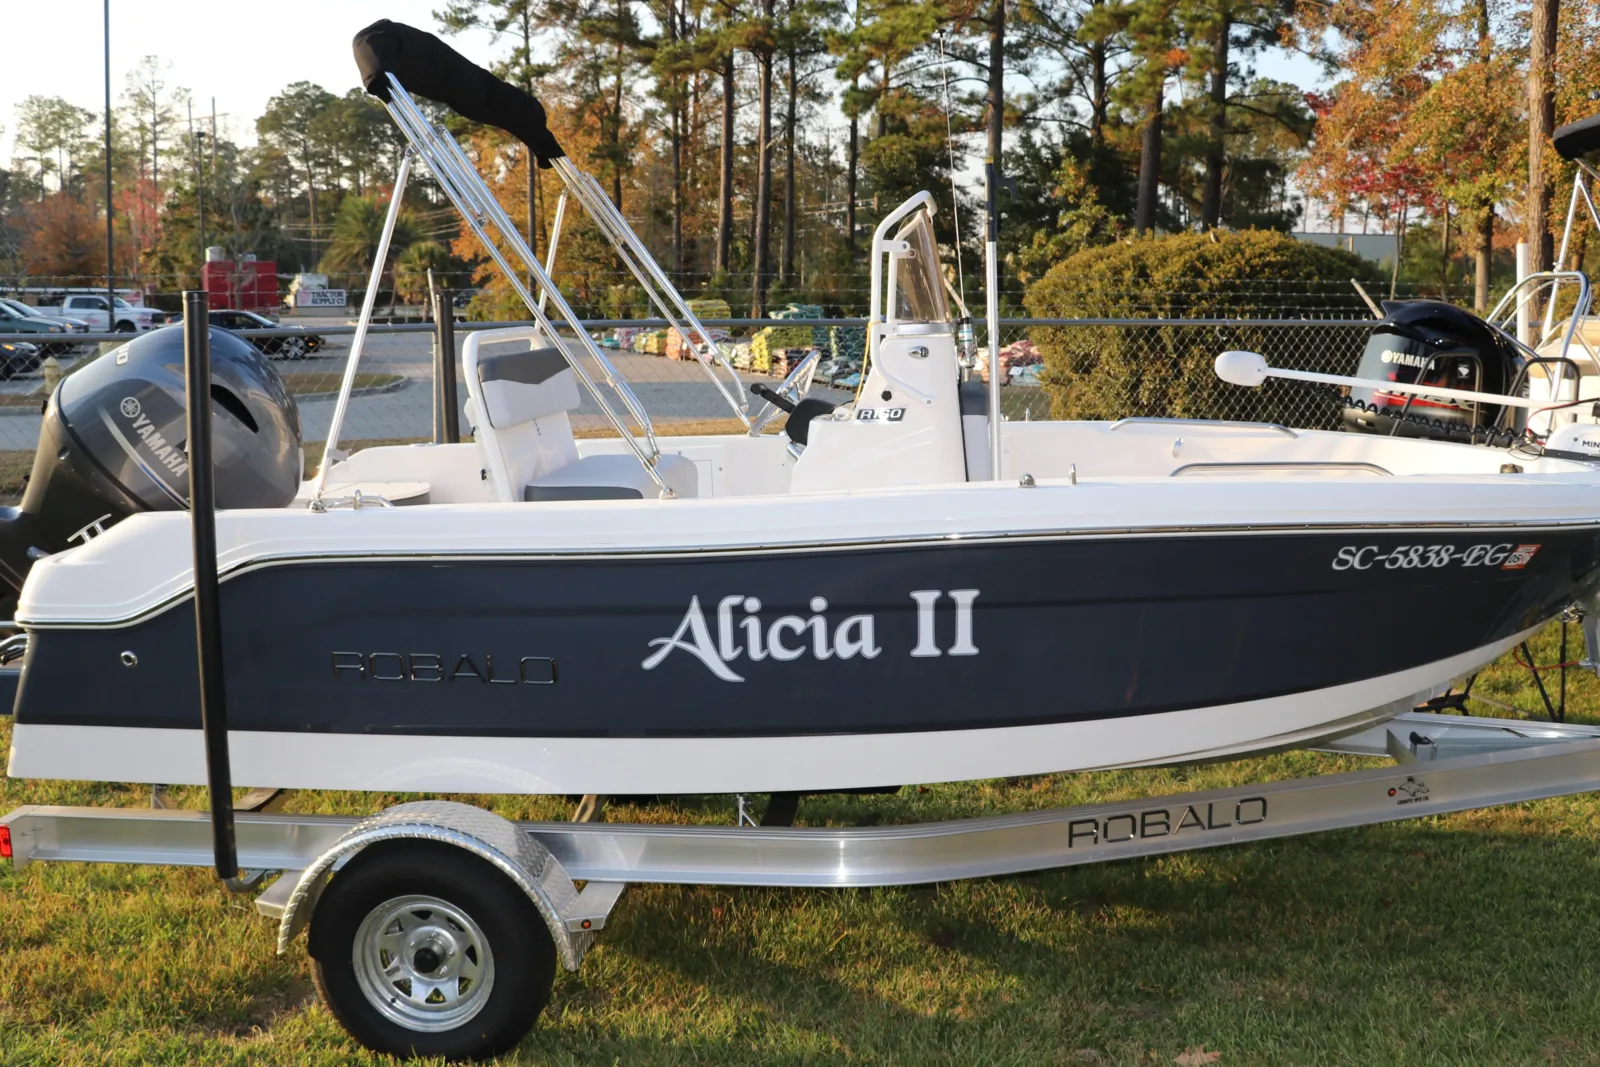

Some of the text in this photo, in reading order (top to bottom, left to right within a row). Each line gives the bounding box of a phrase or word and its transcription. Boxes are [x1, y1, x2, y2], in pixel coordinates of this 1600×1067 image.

[1393, 351, 1435, 370] YAMAHA
[132, 412, 189, 478] YAMAHA
[1331, 544, 1513, 571] SC-5838-EG
[641, 589, 980, 684] Alicia II
[333, 651, 558, 686] ROBALO
[1069, 796, 1268, 848] ROBALO
